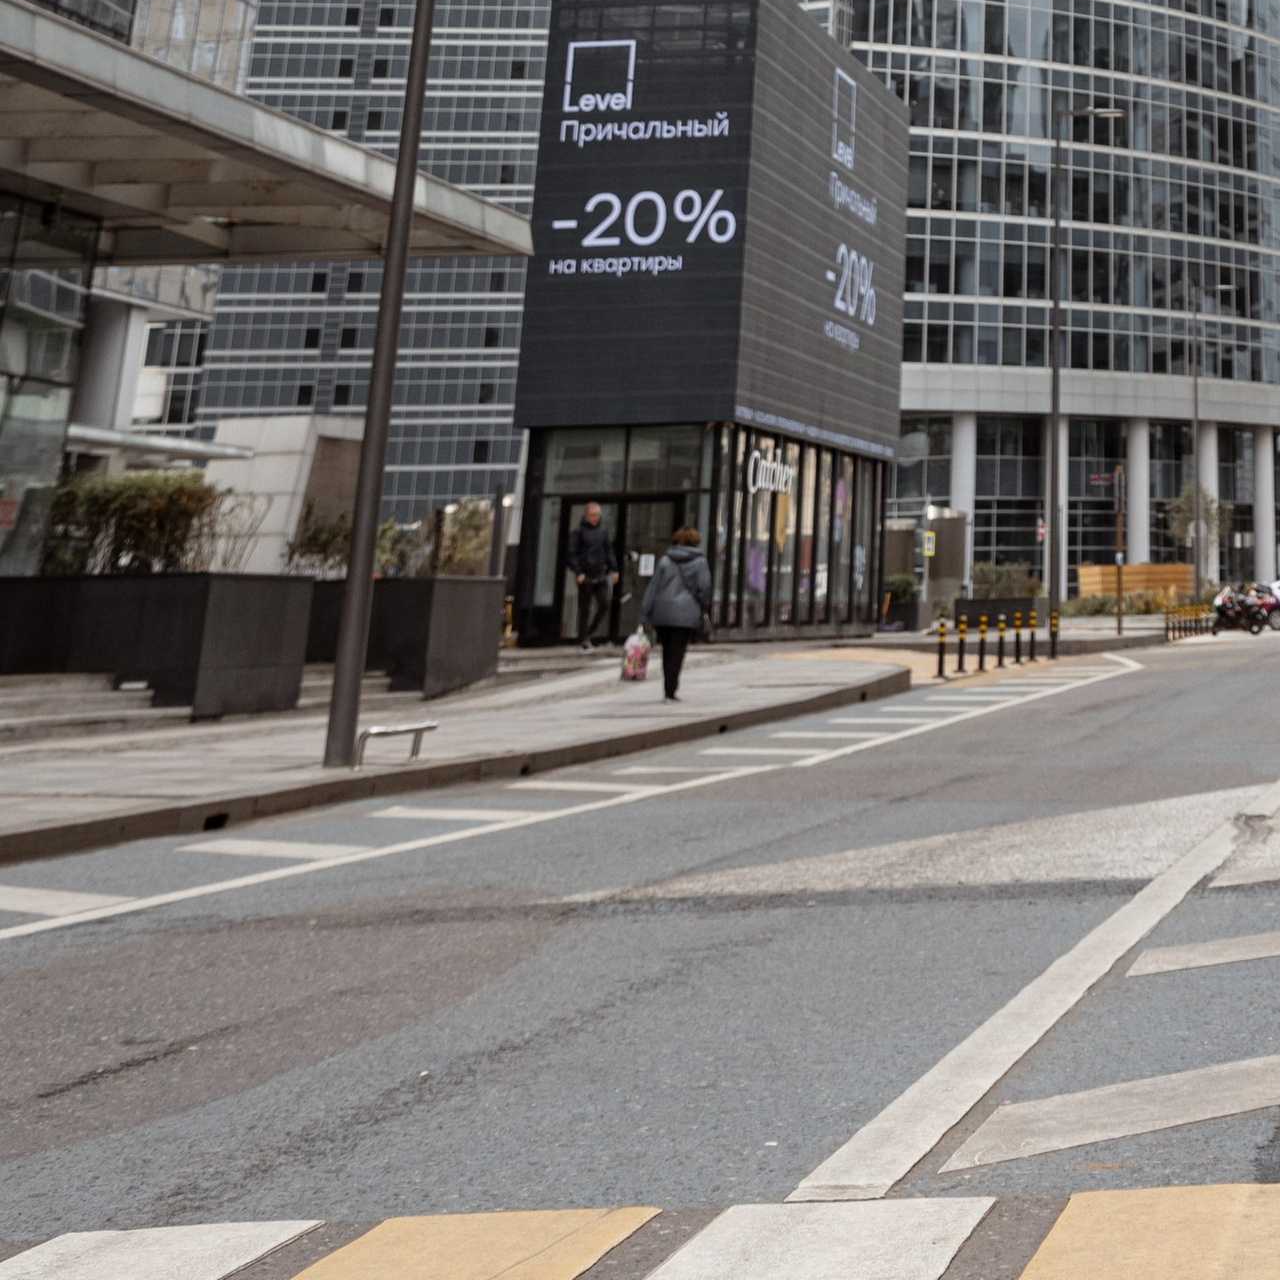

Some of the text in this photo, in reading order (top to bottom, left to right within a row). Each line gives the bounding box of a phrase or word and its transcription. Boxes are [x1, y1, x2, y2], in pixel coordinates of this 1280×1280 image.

[562, 82, 633, 113] Level
[559, 111, 730, 148] Причальный
[551, 189, 737, 248] -20%
[549, 255, 683, 277] на квартиры
[825, 242, 877, 327] -20%
[747, 447, 795, 495] Catcher
